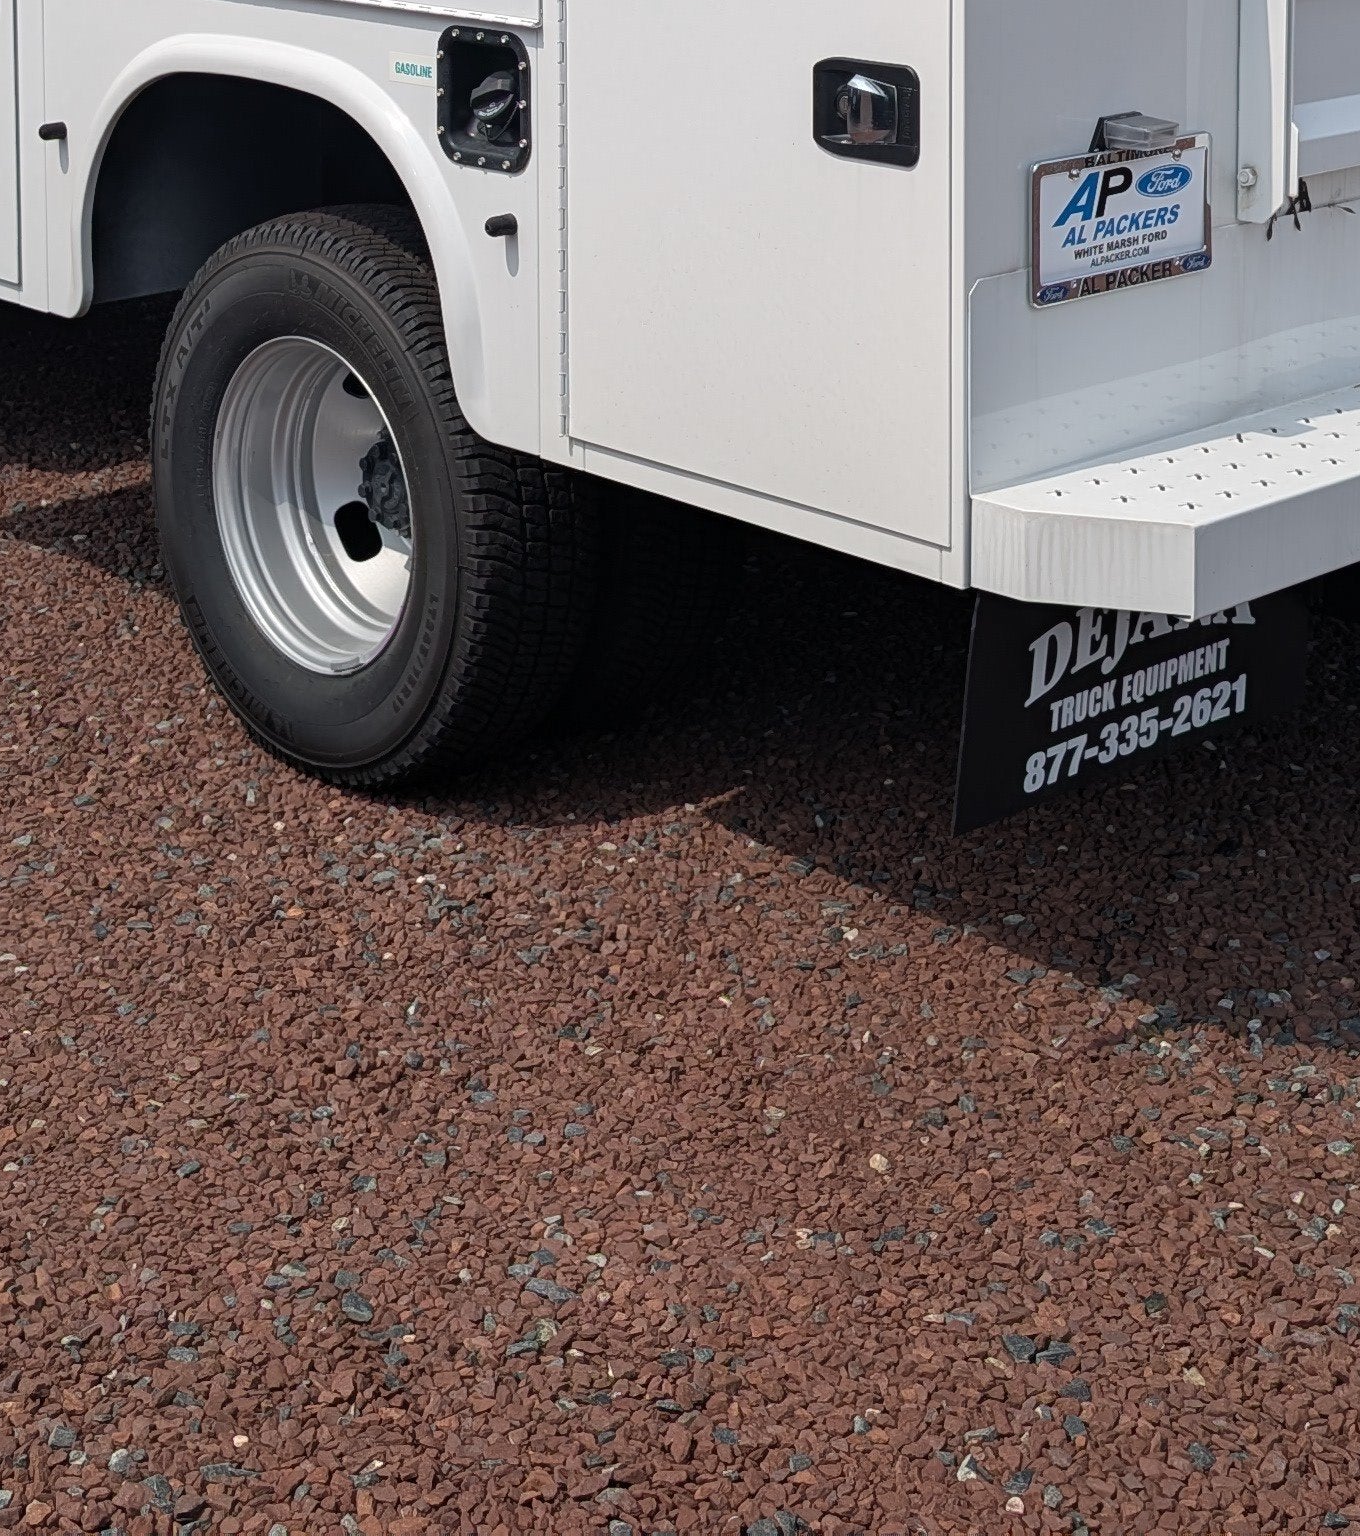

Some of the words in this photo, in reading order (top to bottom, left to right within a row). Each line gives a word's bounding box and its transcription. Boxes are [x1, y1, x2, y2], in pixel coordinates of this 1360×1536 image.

[395, 61, 433, 78] GASOLINE
[1052, 167, 1133, 228] AP
[1062, 225, 1087, 248] AL
[1093, 204, 1181, 241] PACKERS
[1074, 245, 1105, 261] WHITE
[1106, 237, 1140, 254] MARSH
[1142, 229, 1168, 245] FORD
[1090, 246, 1150, 268] ALPACKER.COM
[1080, 277, 1100, 297] AL
[1106, 260, 1173, 290] PACKER
[1050, 679, 1116, 733] TRUCK
[1120, 638, 1231, 706] EQUIPMENT
[1023, 674, 1248, 794] 877-335-2621
